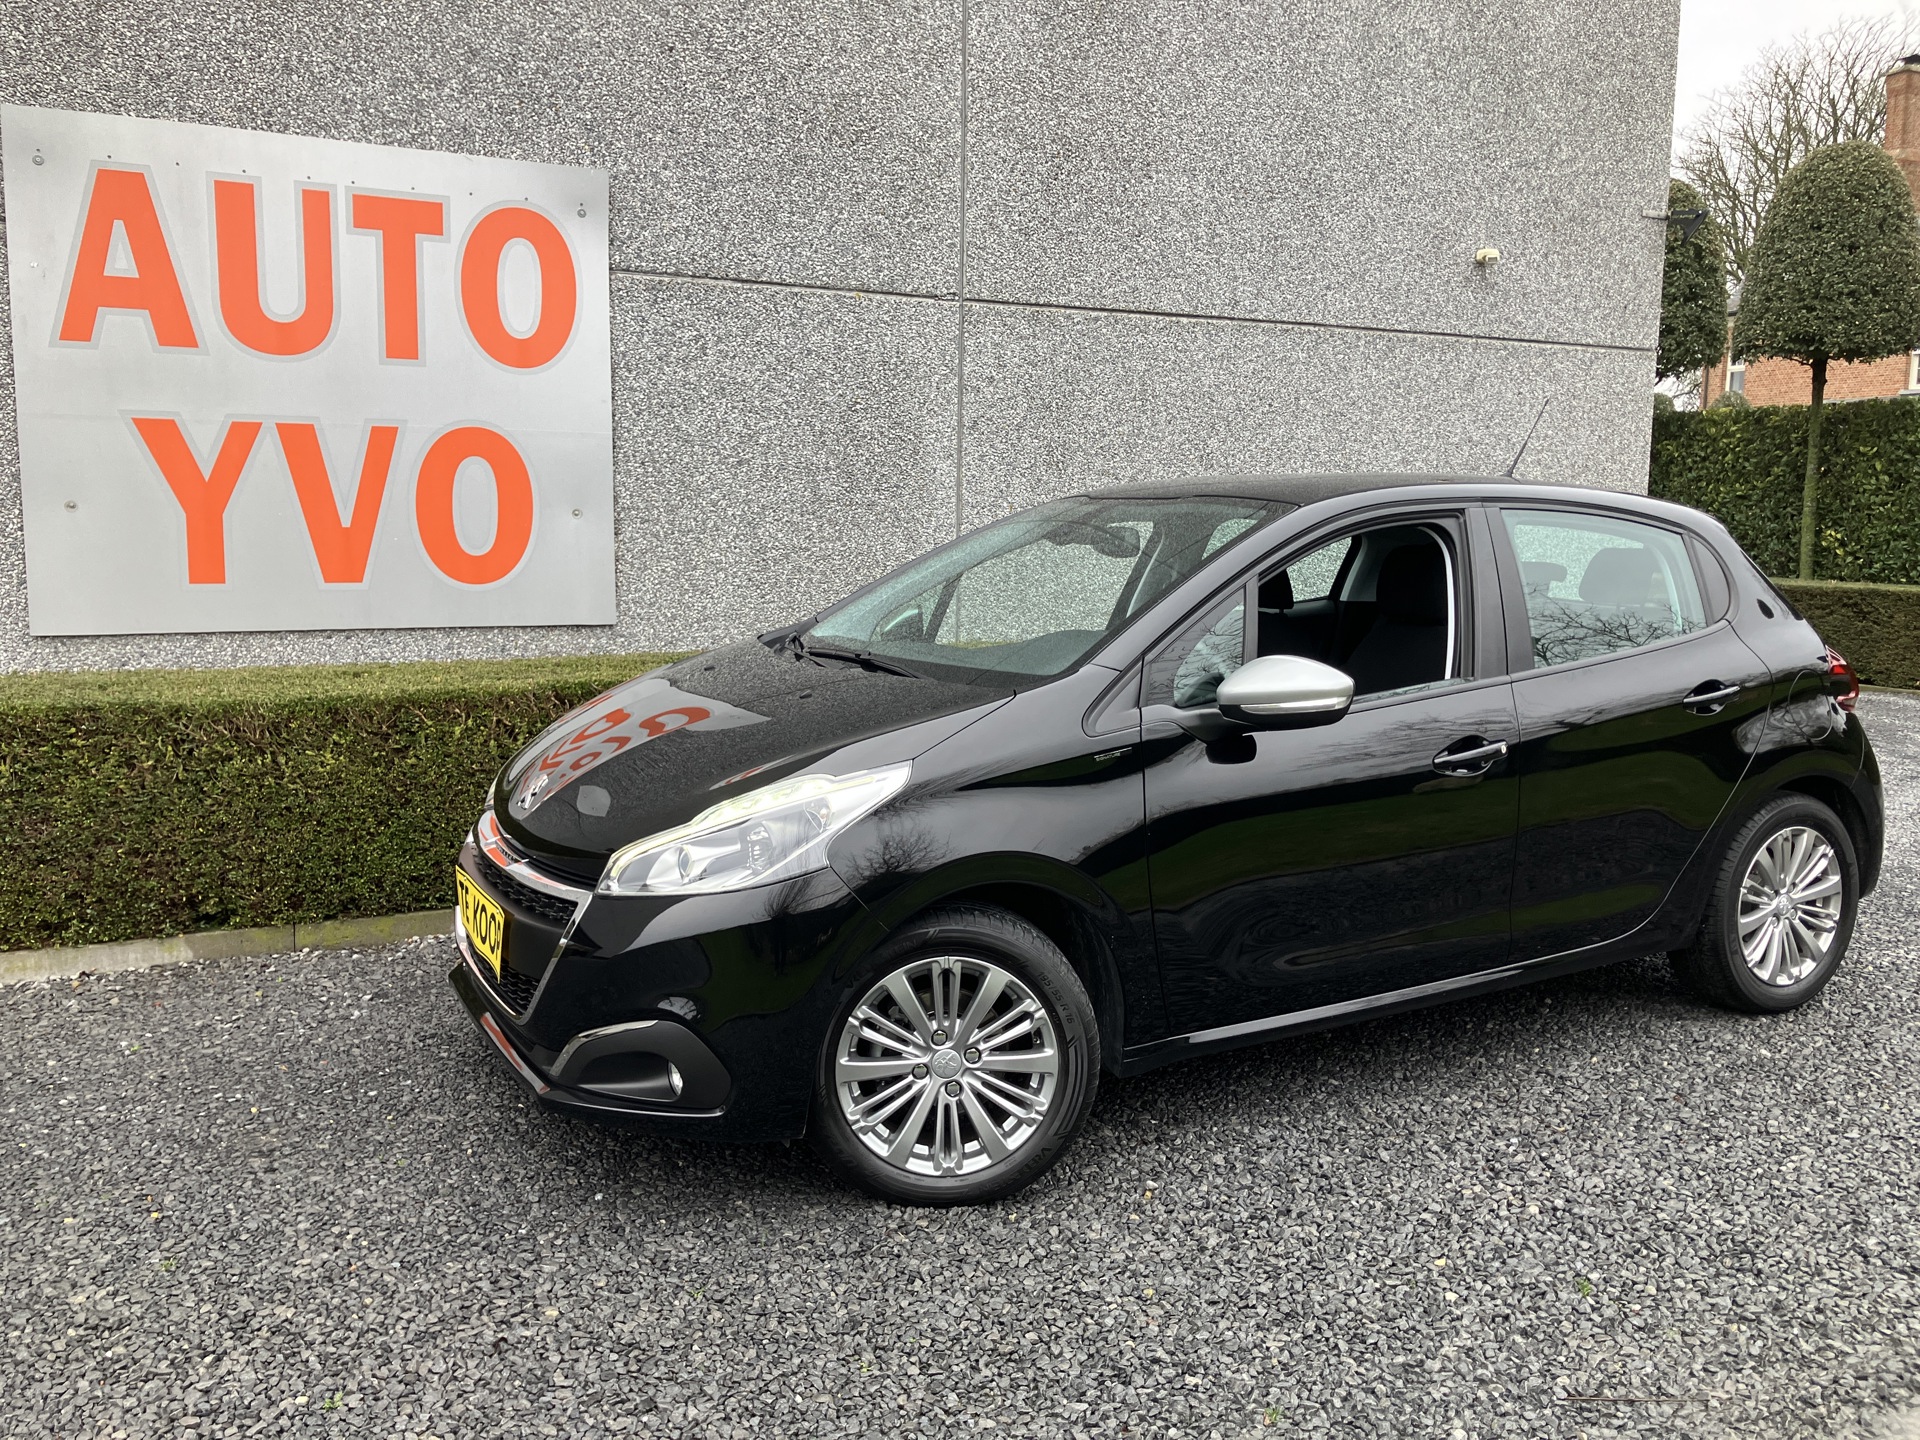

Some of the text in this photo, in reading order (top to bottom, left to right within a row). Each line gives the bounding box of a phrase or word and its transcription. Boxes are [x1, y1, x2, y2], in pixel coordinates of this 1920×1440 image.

[58, 168, 578, 370] AUTO
[131, 417, 534, 585] YVO
[459, 879, 470, 924] TE
[1038, 971, 1064, 1002] 195/55
